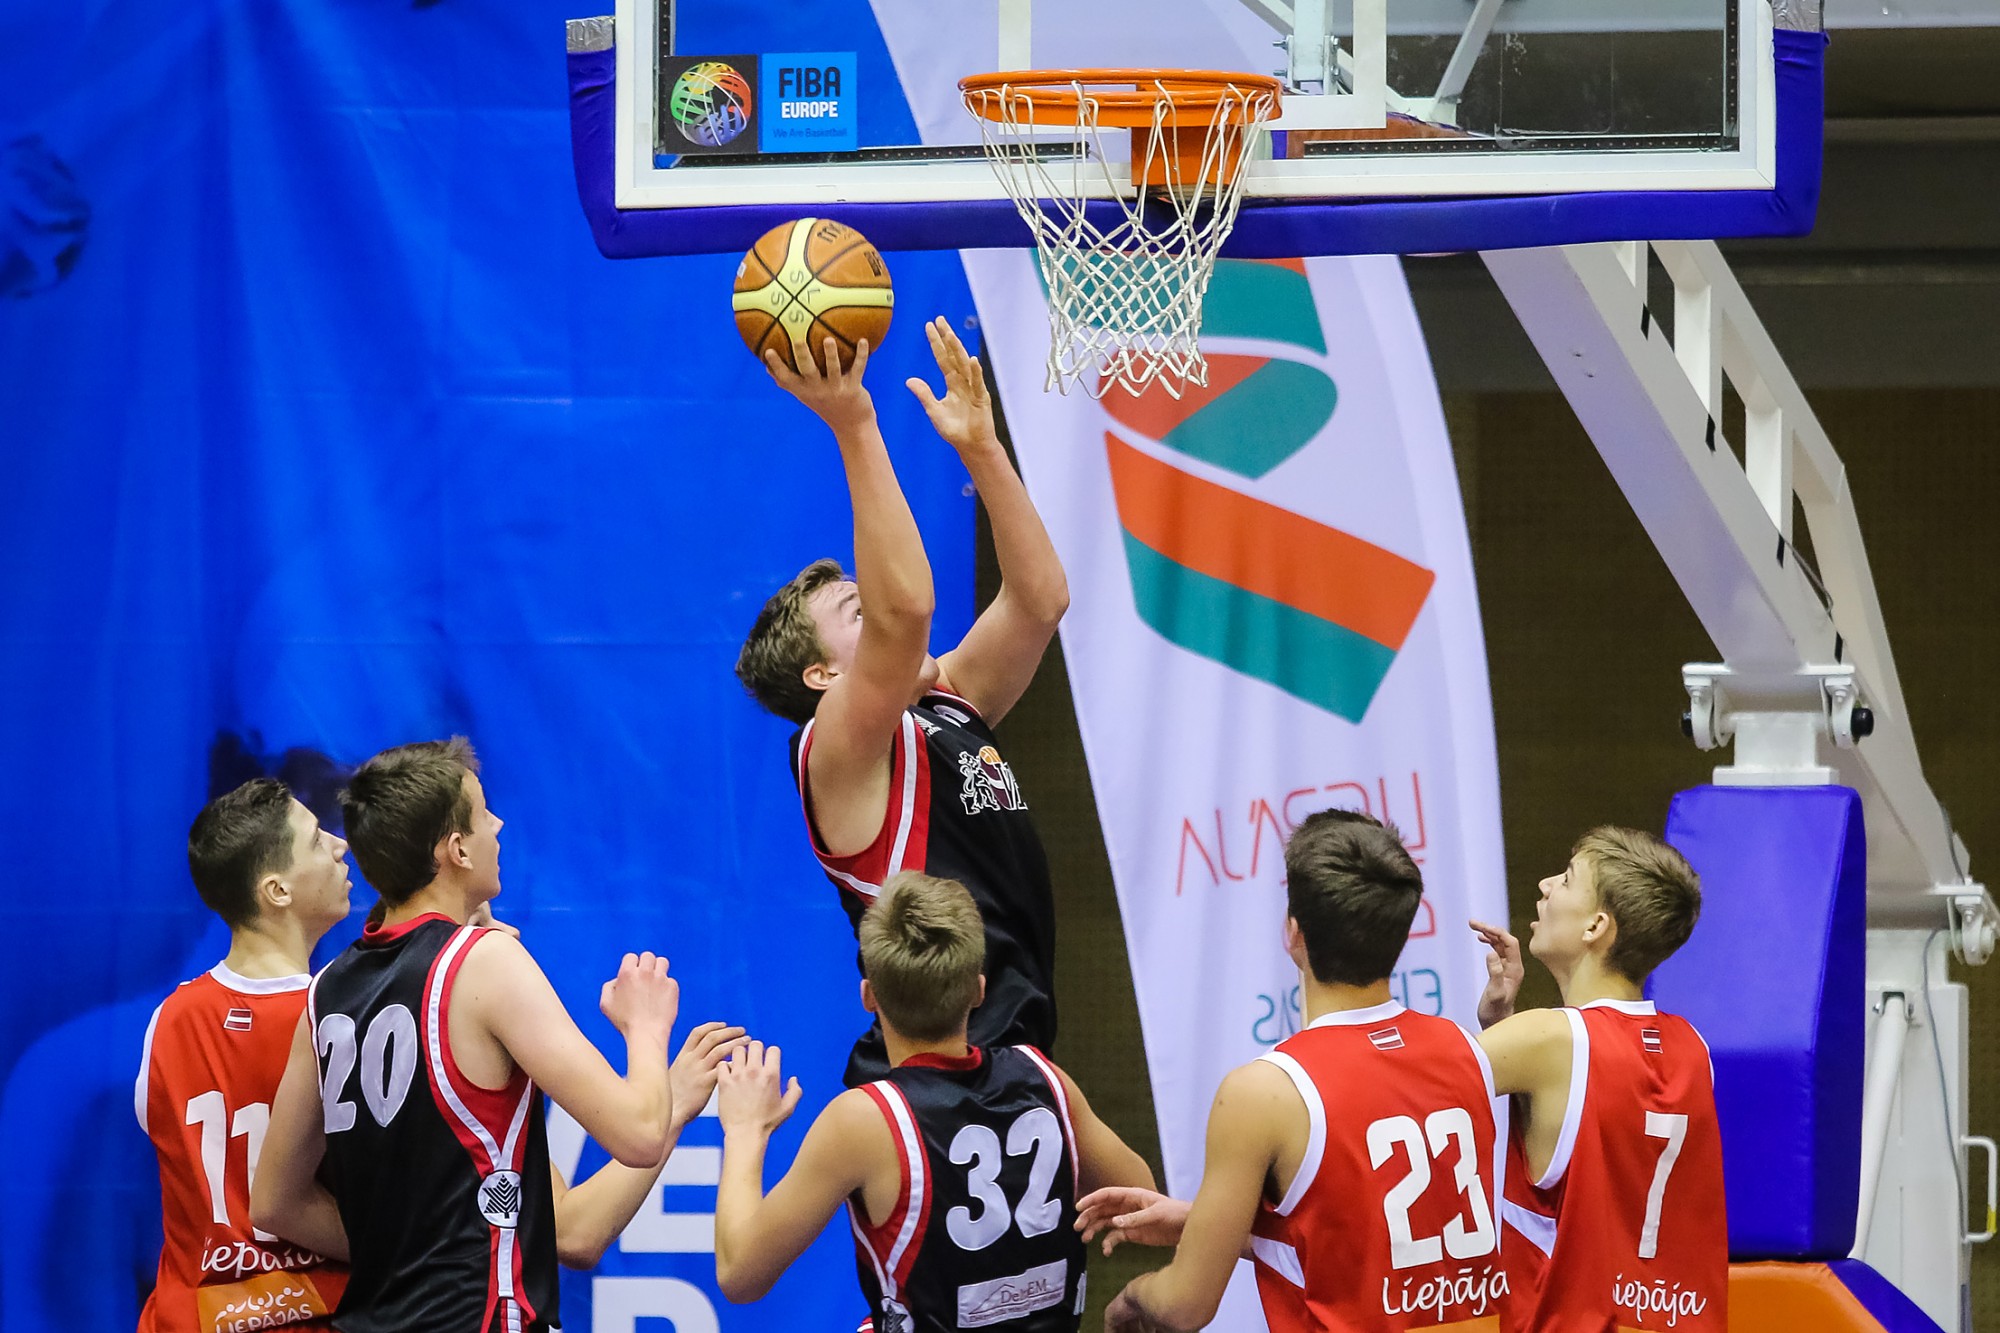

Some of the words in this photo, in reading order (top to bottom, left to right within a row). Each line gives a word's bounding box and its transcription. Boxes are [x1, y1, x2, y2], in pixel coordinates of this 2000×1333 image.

[779, 66, 841, 98] FIBA
[781, 101, 839, 119] EUROPE
[805, 127, 848, 138] Basketball
[317, 1003, 418, 1134] 20
[946, 1107, 1063, 1251] 32
[1366, 1107, 1496, 1270] 23
[1638, 1110, 1688, 1259] 7
[1382, 1265, 1511, 1322] Liepāja
[1612, 1273, 1707, 1327] iepāja
